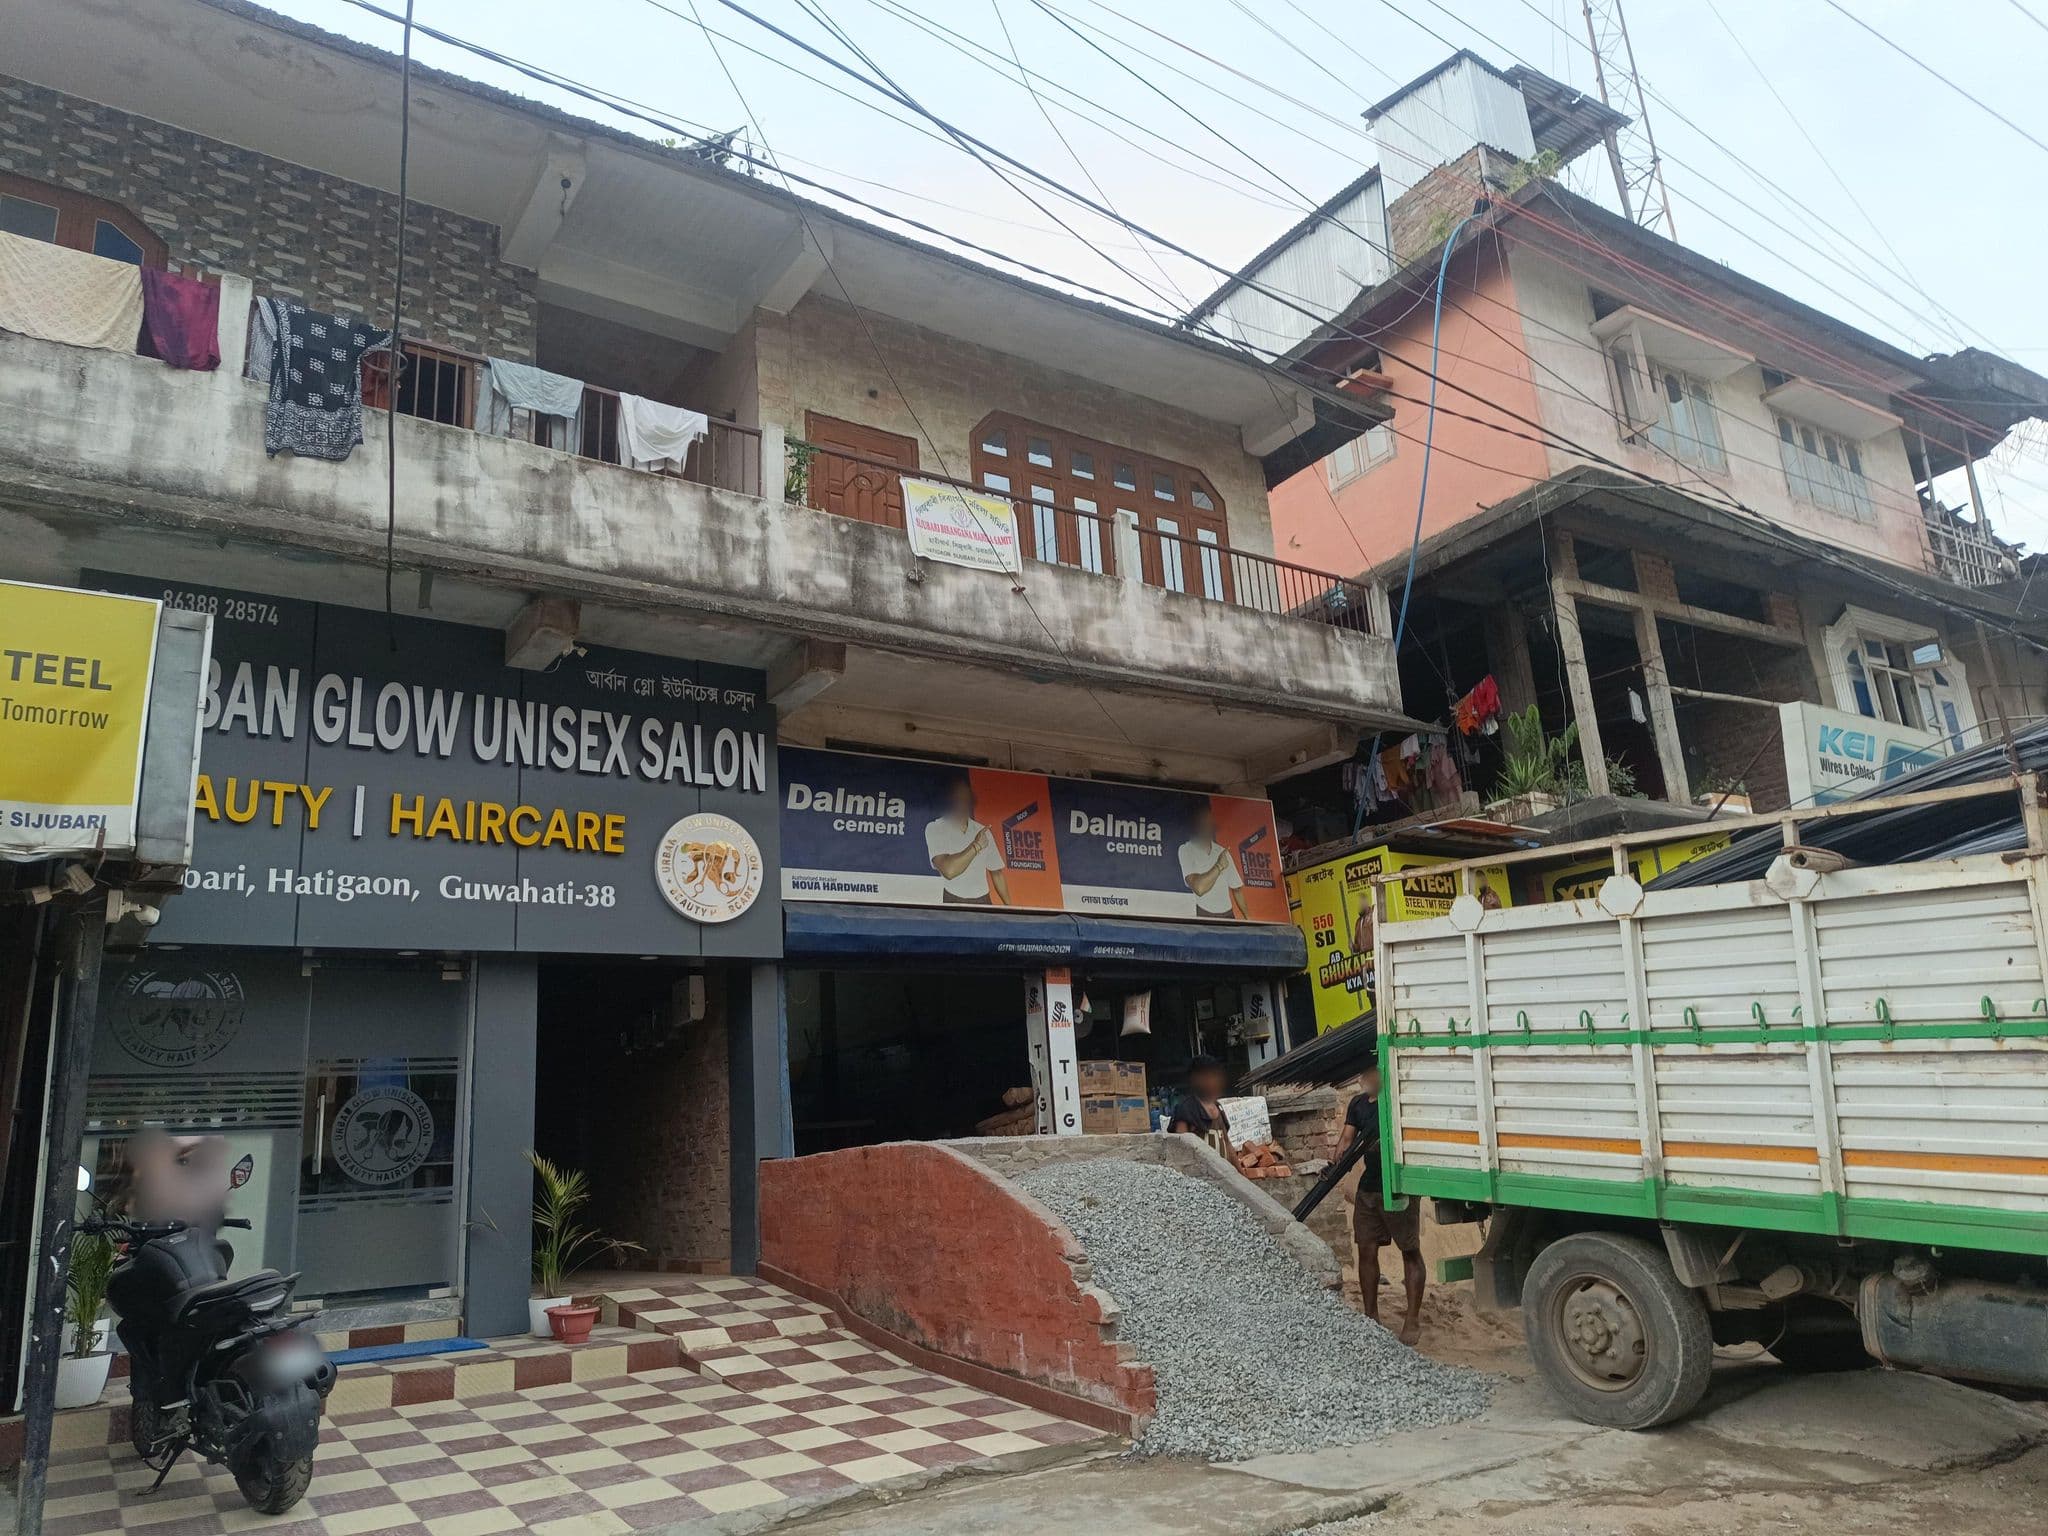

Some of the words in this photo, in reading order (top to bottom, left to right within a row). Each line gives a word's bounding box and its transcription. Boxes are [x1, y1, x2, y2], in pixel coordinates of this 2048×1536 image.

[163, 589, 218, 616] 86388
[224, 598, 280, 625] 28574
[4, 649, 112, 691] TEEL
[1, 697, 109, 730] Tomorrow
[313, 673, 464, 757] GLOW
[473, 694, 632, 775] UNISEX
[640, 717, 766, 792] SALON
[1819, 724, 1875, 762] KEI
[1820, 757, 1844, 774] Wires
[1844, 764, 1850, 775] &
[1850, 763, 1875, 780] Cables
[787, 782, 906, 818] Dalmia
[10, 811, 107, 830] SIJUBARI
[390, 792, 626, 854] HAIRCARE
[833, 819, 905, 836] cement
[1070, 810, 1161, 841] Dalmia
[1106, 841, 1162, 857] cement
[1346, 860, 1380, 880] XTECH
[267, 867, 420, 903] Hatigaon,
[439, 875, 616, 907] Guwahati-38
[792, 880, 820, 891] NOVA
[823, 882, 879, 893] HARDWARE
[1404, 875, 1454, 894] XTECH
[670, 889, 707, 917] BEAUTY
[1405, 897, 1424, 909] STEEL
[1426, 899, 1437, 909] TMT
[1312, 913, 1334, 931] 550
[1315, 929, 1335, 948] SD
[1330, 951, 1341, 964] AB
[1347, 975, 1363, 990] KYA
[335, 1107, 353, 1141] URBAN
[384, 1087, 418, 1107] UNISEX
[415, 1105, 432, 1137] SALON
[339, 1153, 374, 1180] BEAUTY
[376, 1152, 425, 1182] HAIRCARE
